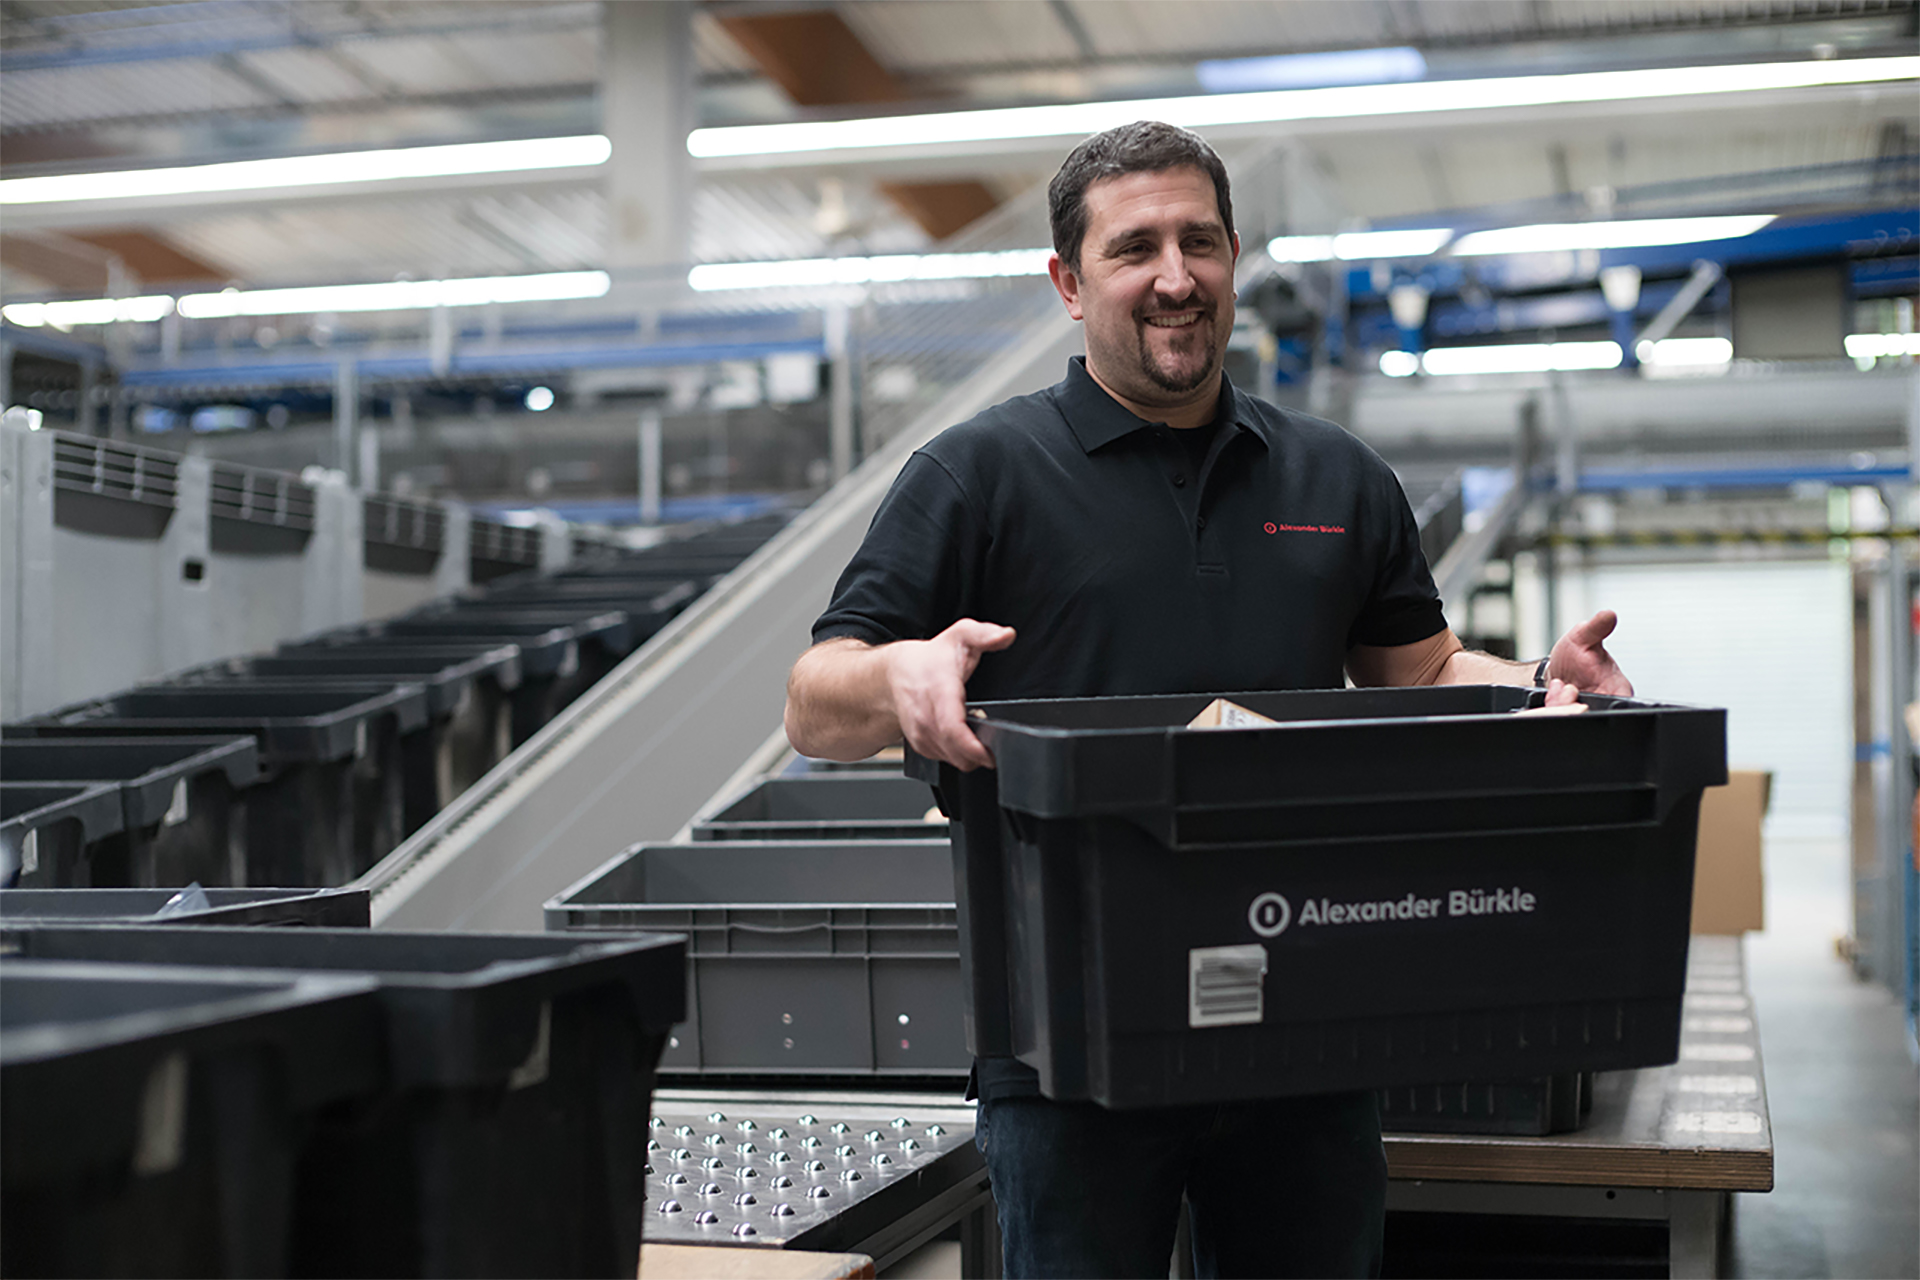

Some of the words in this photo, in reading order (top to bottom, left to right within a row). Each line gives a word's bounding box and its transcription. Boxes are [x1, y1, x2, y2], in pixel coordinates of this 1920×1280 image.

[1280, 524, 1319, 532] Alexander
[1298, 893, 1442, 925] Alexander
[1449, 887, 1536, 916] Bürkle
